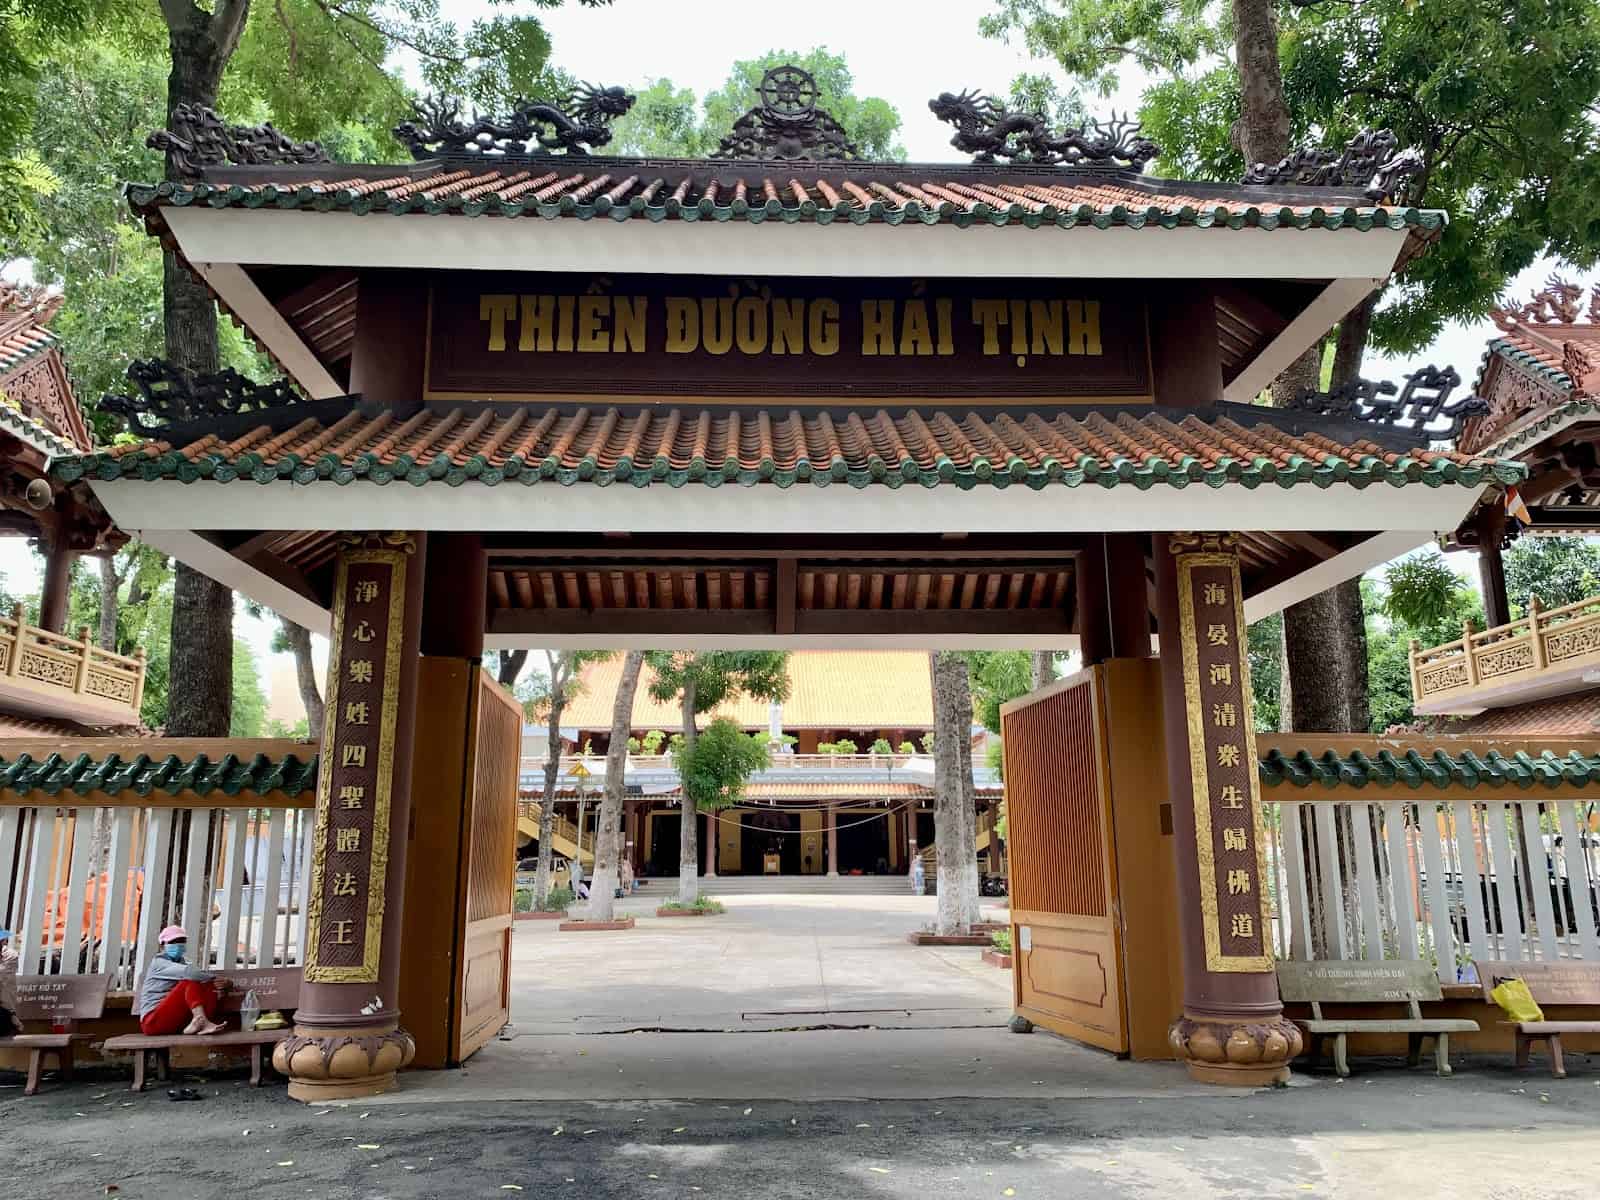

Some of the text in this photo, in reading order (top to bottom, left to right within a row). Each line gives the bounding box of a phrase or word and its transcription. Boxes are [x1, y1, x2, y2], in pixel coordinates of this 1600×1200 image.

[665, 280, 840, 356] ĐƯỜNG
[861, 279, 955, 355] HẢI
[972, 298, 1103, 367] TỊNH
